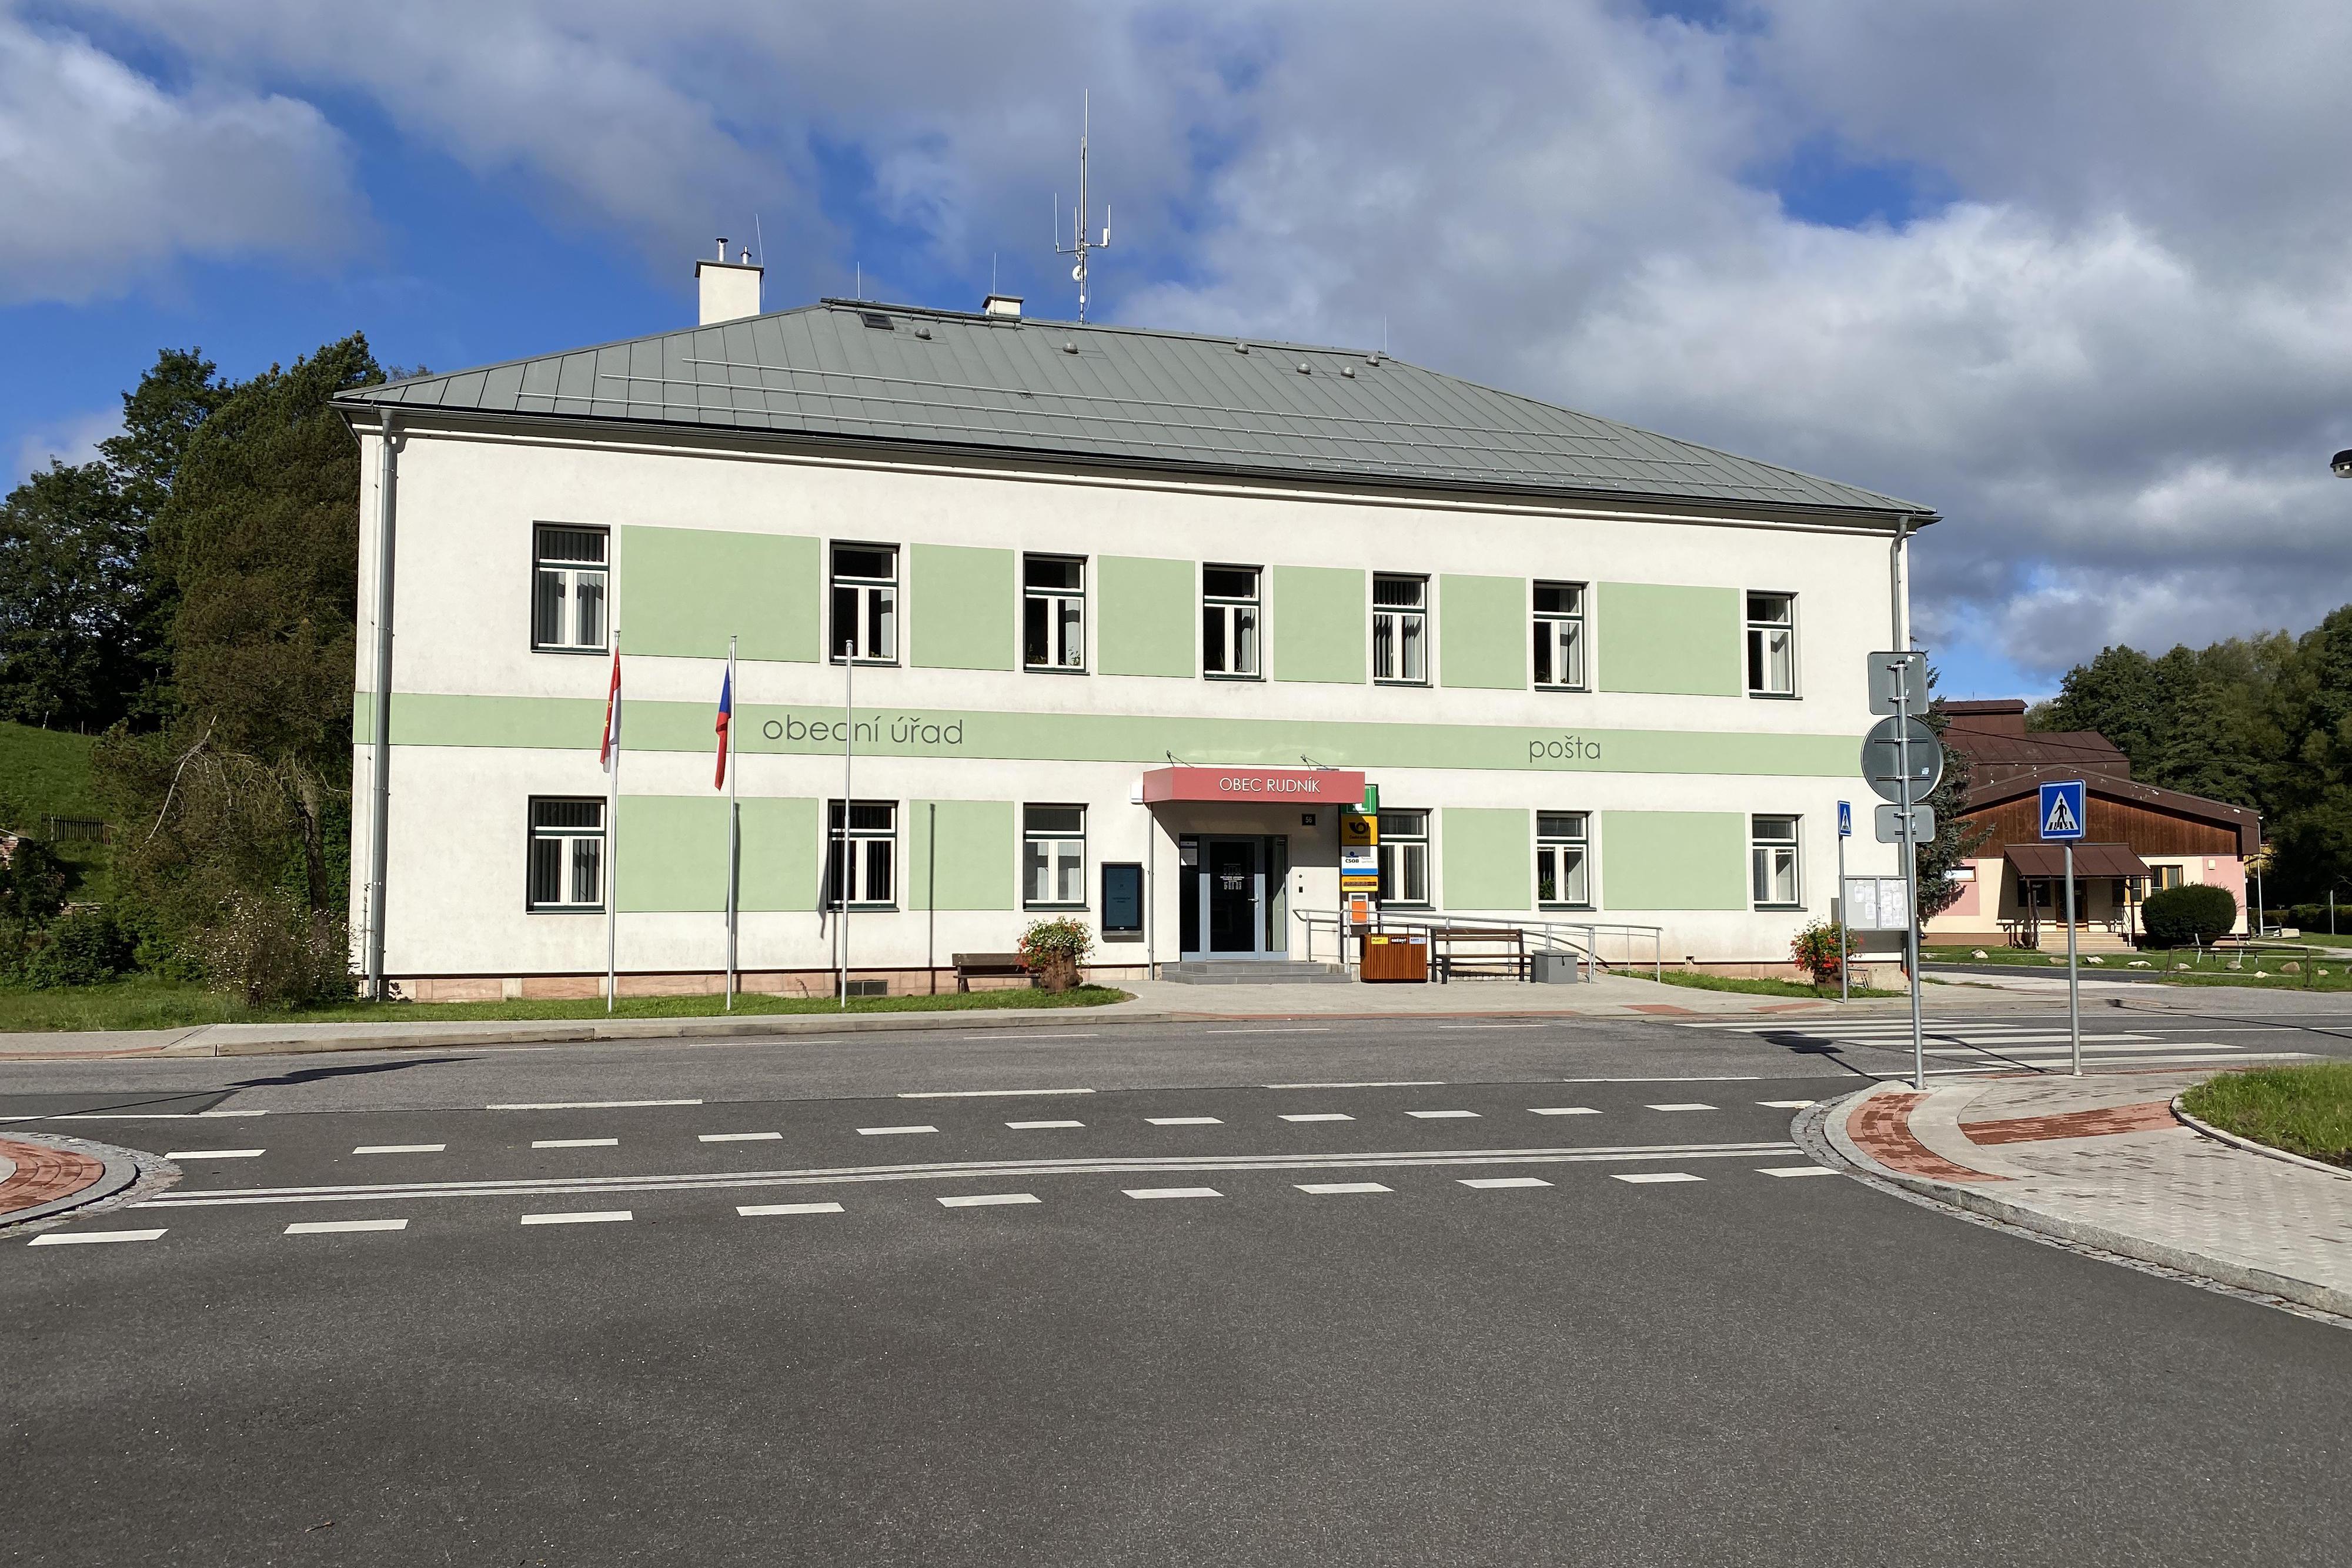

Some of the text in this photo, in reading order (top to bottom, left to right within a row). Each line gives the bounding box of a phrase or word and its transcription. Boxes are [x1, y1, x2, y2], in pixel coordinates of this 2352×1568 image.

[763, 714, 963, 744] obecní úřad
[1529, 735, 1601, 763] pošta
[1220, 776, 1321, 793] OBEC RUDNÍK
